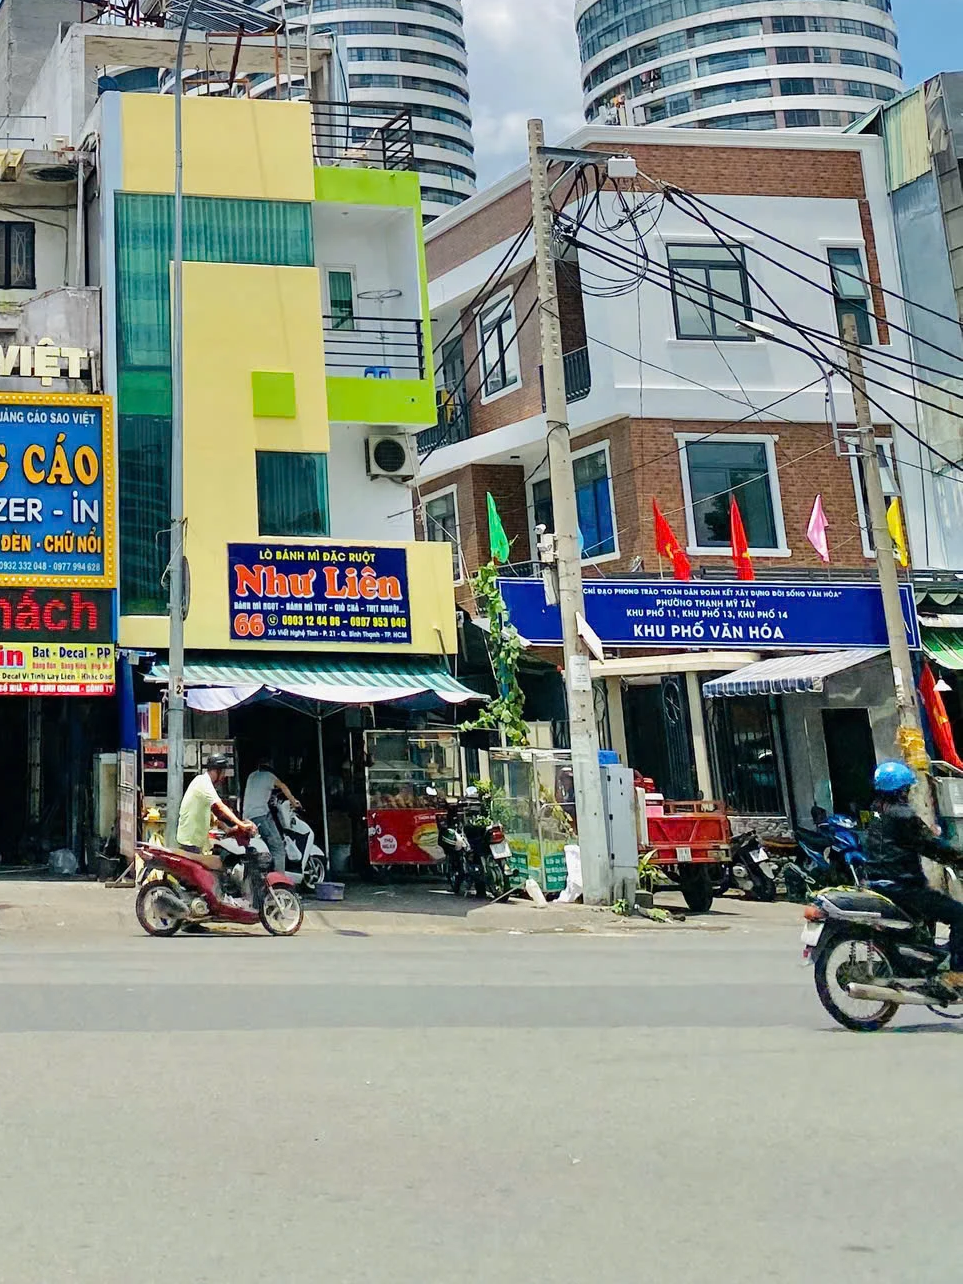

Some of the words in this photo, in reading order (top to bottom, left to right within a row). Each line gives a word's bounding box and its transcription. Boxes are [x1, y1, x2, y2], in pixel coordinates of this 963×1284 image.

[27, 409, 48, 424] CÁO
[50, 412, 70, 424] SAO
[73, 411, 96, 428] VIỆT
[22, 432, 100, 486] CÁO
[1, 528, 31, 552] ĐÈN
[44, 530, 74, 553] CHỮ
[77, 526, 102, 554] NỔI
[259, 548, 273, 560] LÒ
[276, 550, 305, 561] BÁNH
[308, 550, 320, 562] MÌ
[323, 550, 346, 564] ĐẶC
[348, 551, 376, 565] RUỘT
[18, 561, 32, 570] 332
[33, 562, 47, 571] 048
[53, 562, 71, 571] 0977
[72, 562, 86, 572] 994
[234, 564, 317, 598] Như
[322, 566, 404, 600] Liên
[597, 588, 612, 596] ĐẠO
[786, 589, 806, 597] SỐNG
[656, 598, 693, 607] PHƯỜNG
[695, 600, 723, 609] THẠNH
[726, 599, 738, 608] MỸ
[740, 599, 756, 608] TÂY
[304, 616, 314, 626] 12
[626, 609, 644, 617] KHU
[646, 607, 664, 617] PHỐ
[667, 610, 680, 618] 11,
[702, 608, 720, 618] PHỐ
[723, 610, 736, 619] 13,
[757, 608, 775, 619] PHỐ
[234, 612, 266, 636] 66
[634, 624, 665, 637] KHU
[671, 620, 705, 638] PHỐ
[710, 622, 743, 638] VĂN
[749, 623, 784, 639] HÓA
[59, 647, 87, 658] Decal
[97, 647, 111, 659] PP
